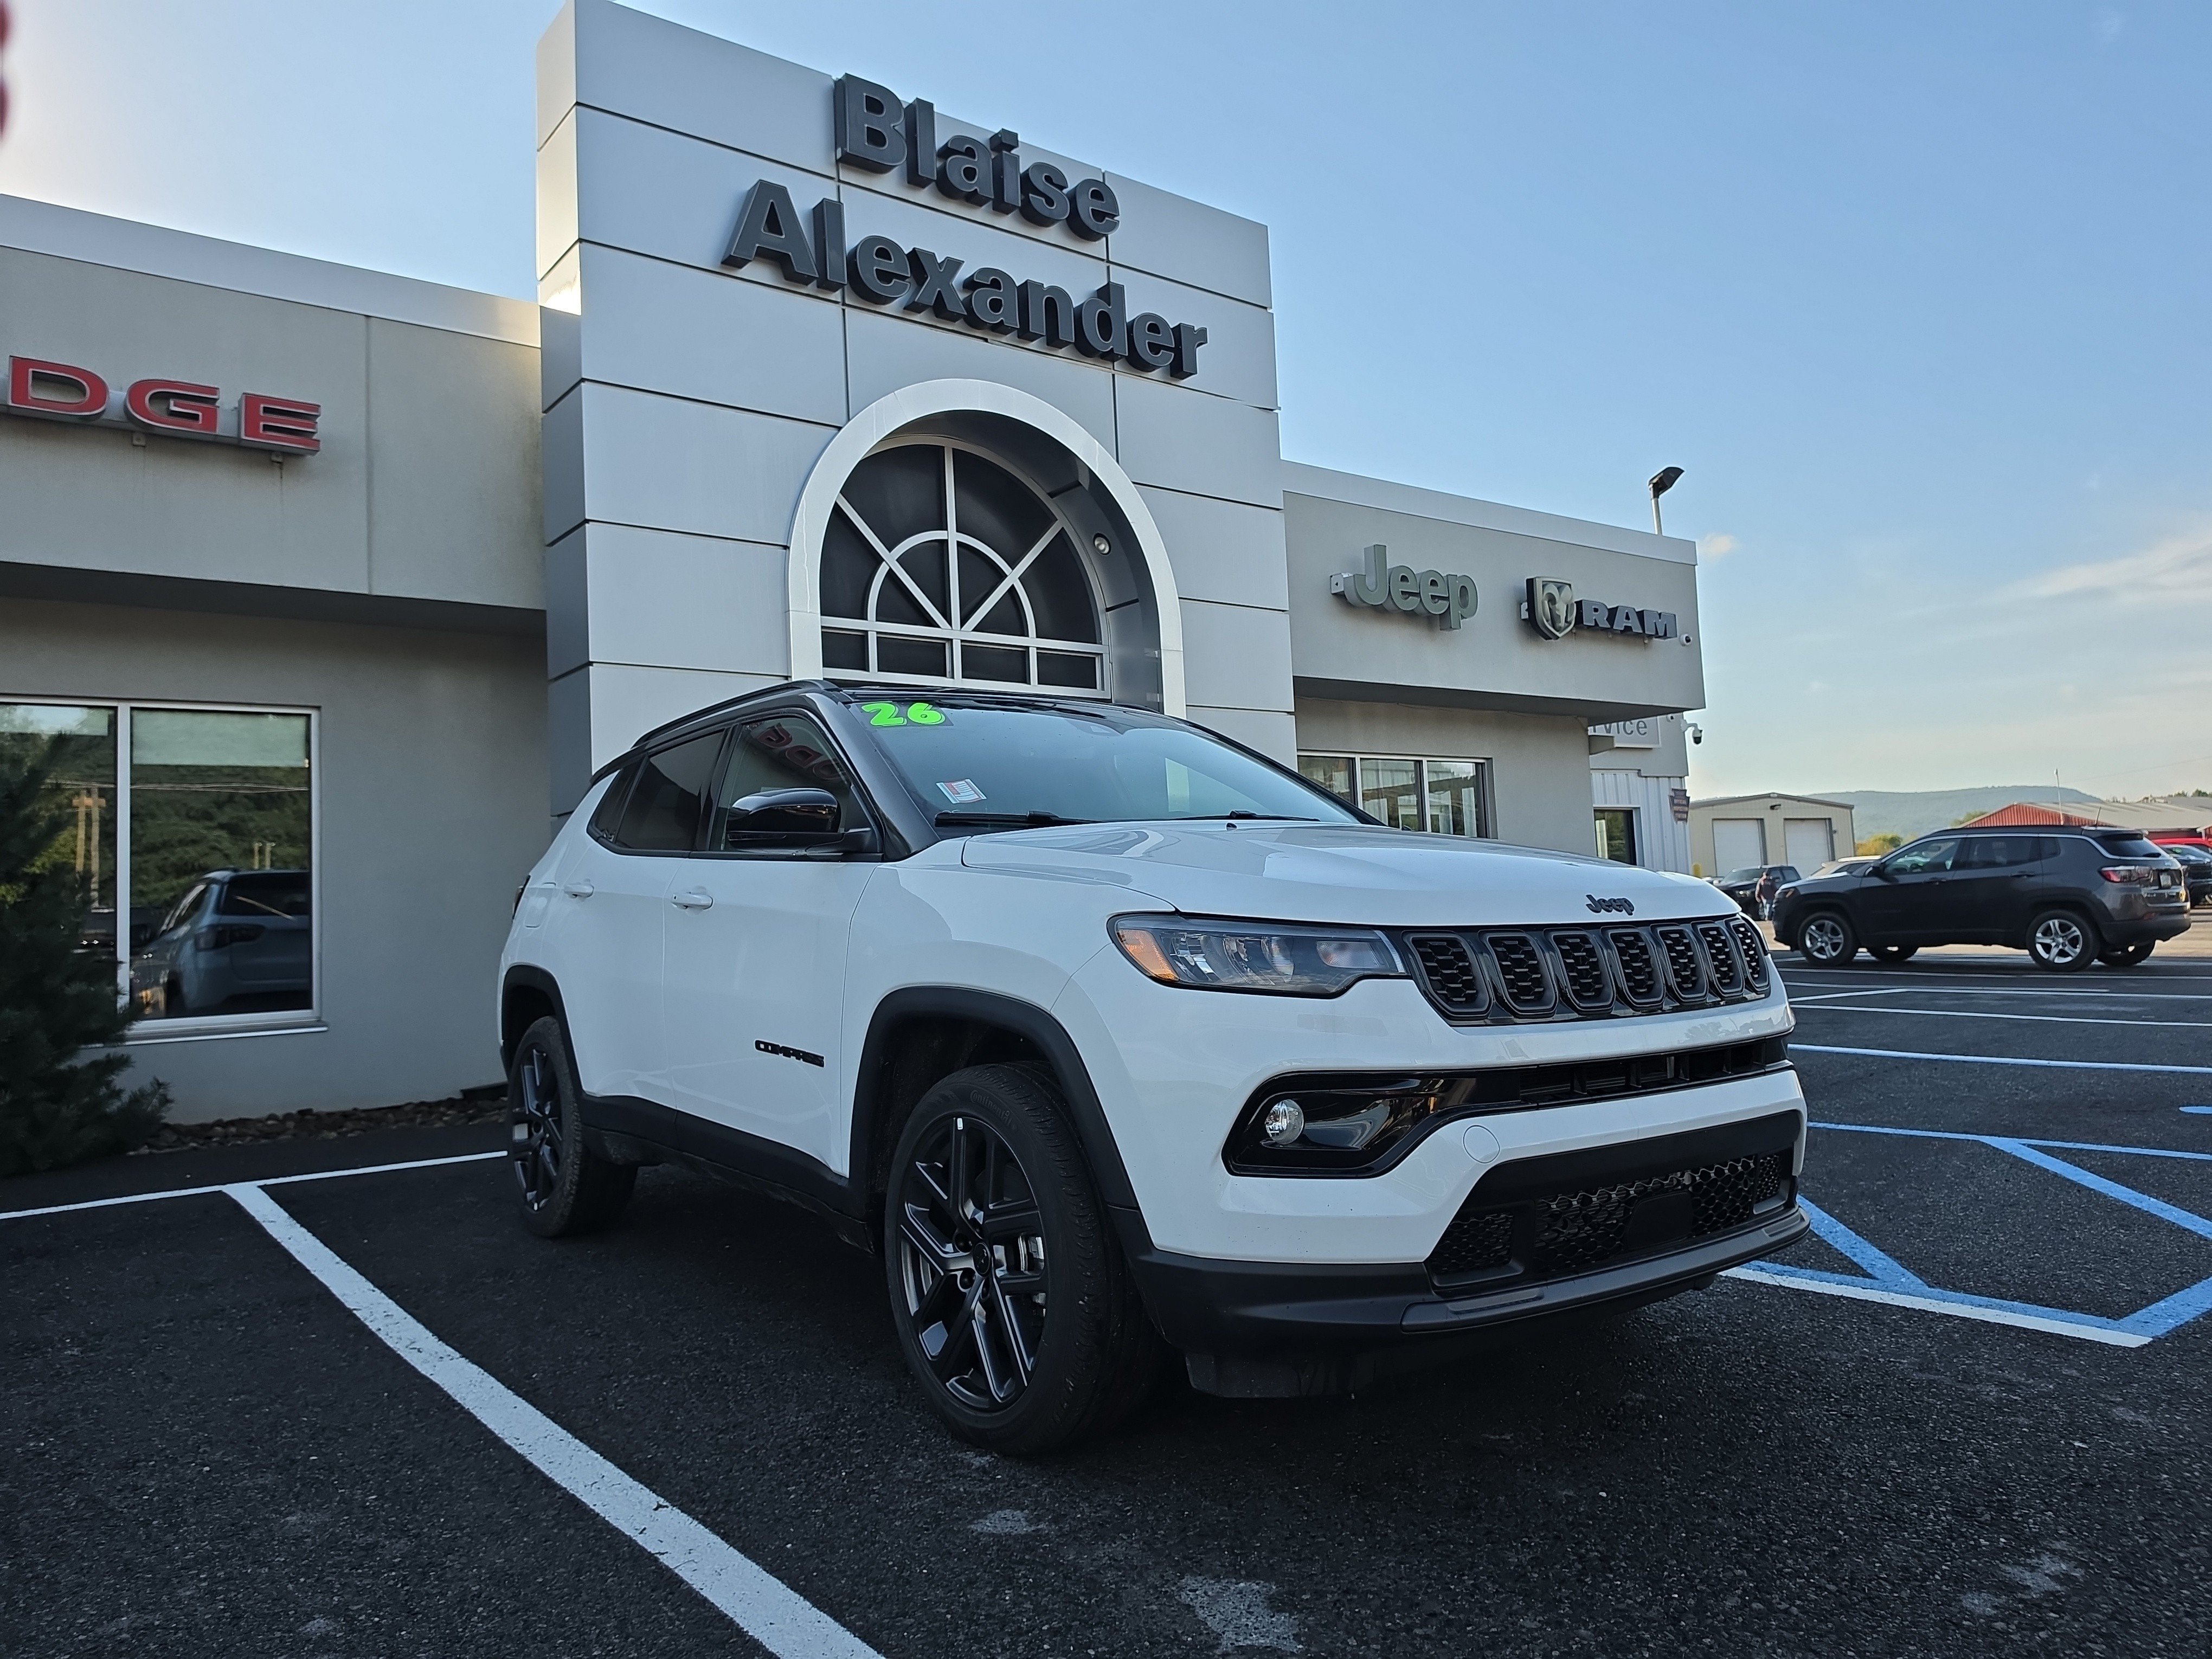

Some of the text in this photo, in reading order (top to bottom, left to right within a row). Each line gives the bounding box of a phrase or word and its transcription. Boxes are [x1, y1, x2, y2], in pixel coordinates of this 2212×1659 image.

[834, 73, 1121, 242] Blaise
[721, 179, 1208, 380] Alexander
[1346, 544, 1478, 631] Jeep
[1577, 599, 1677, 639] RAM
[861, 702, 946, 726] 26
[1586, 894, 1635, 916] Jeep
[969, 1089, 1014, 1126] Continental
